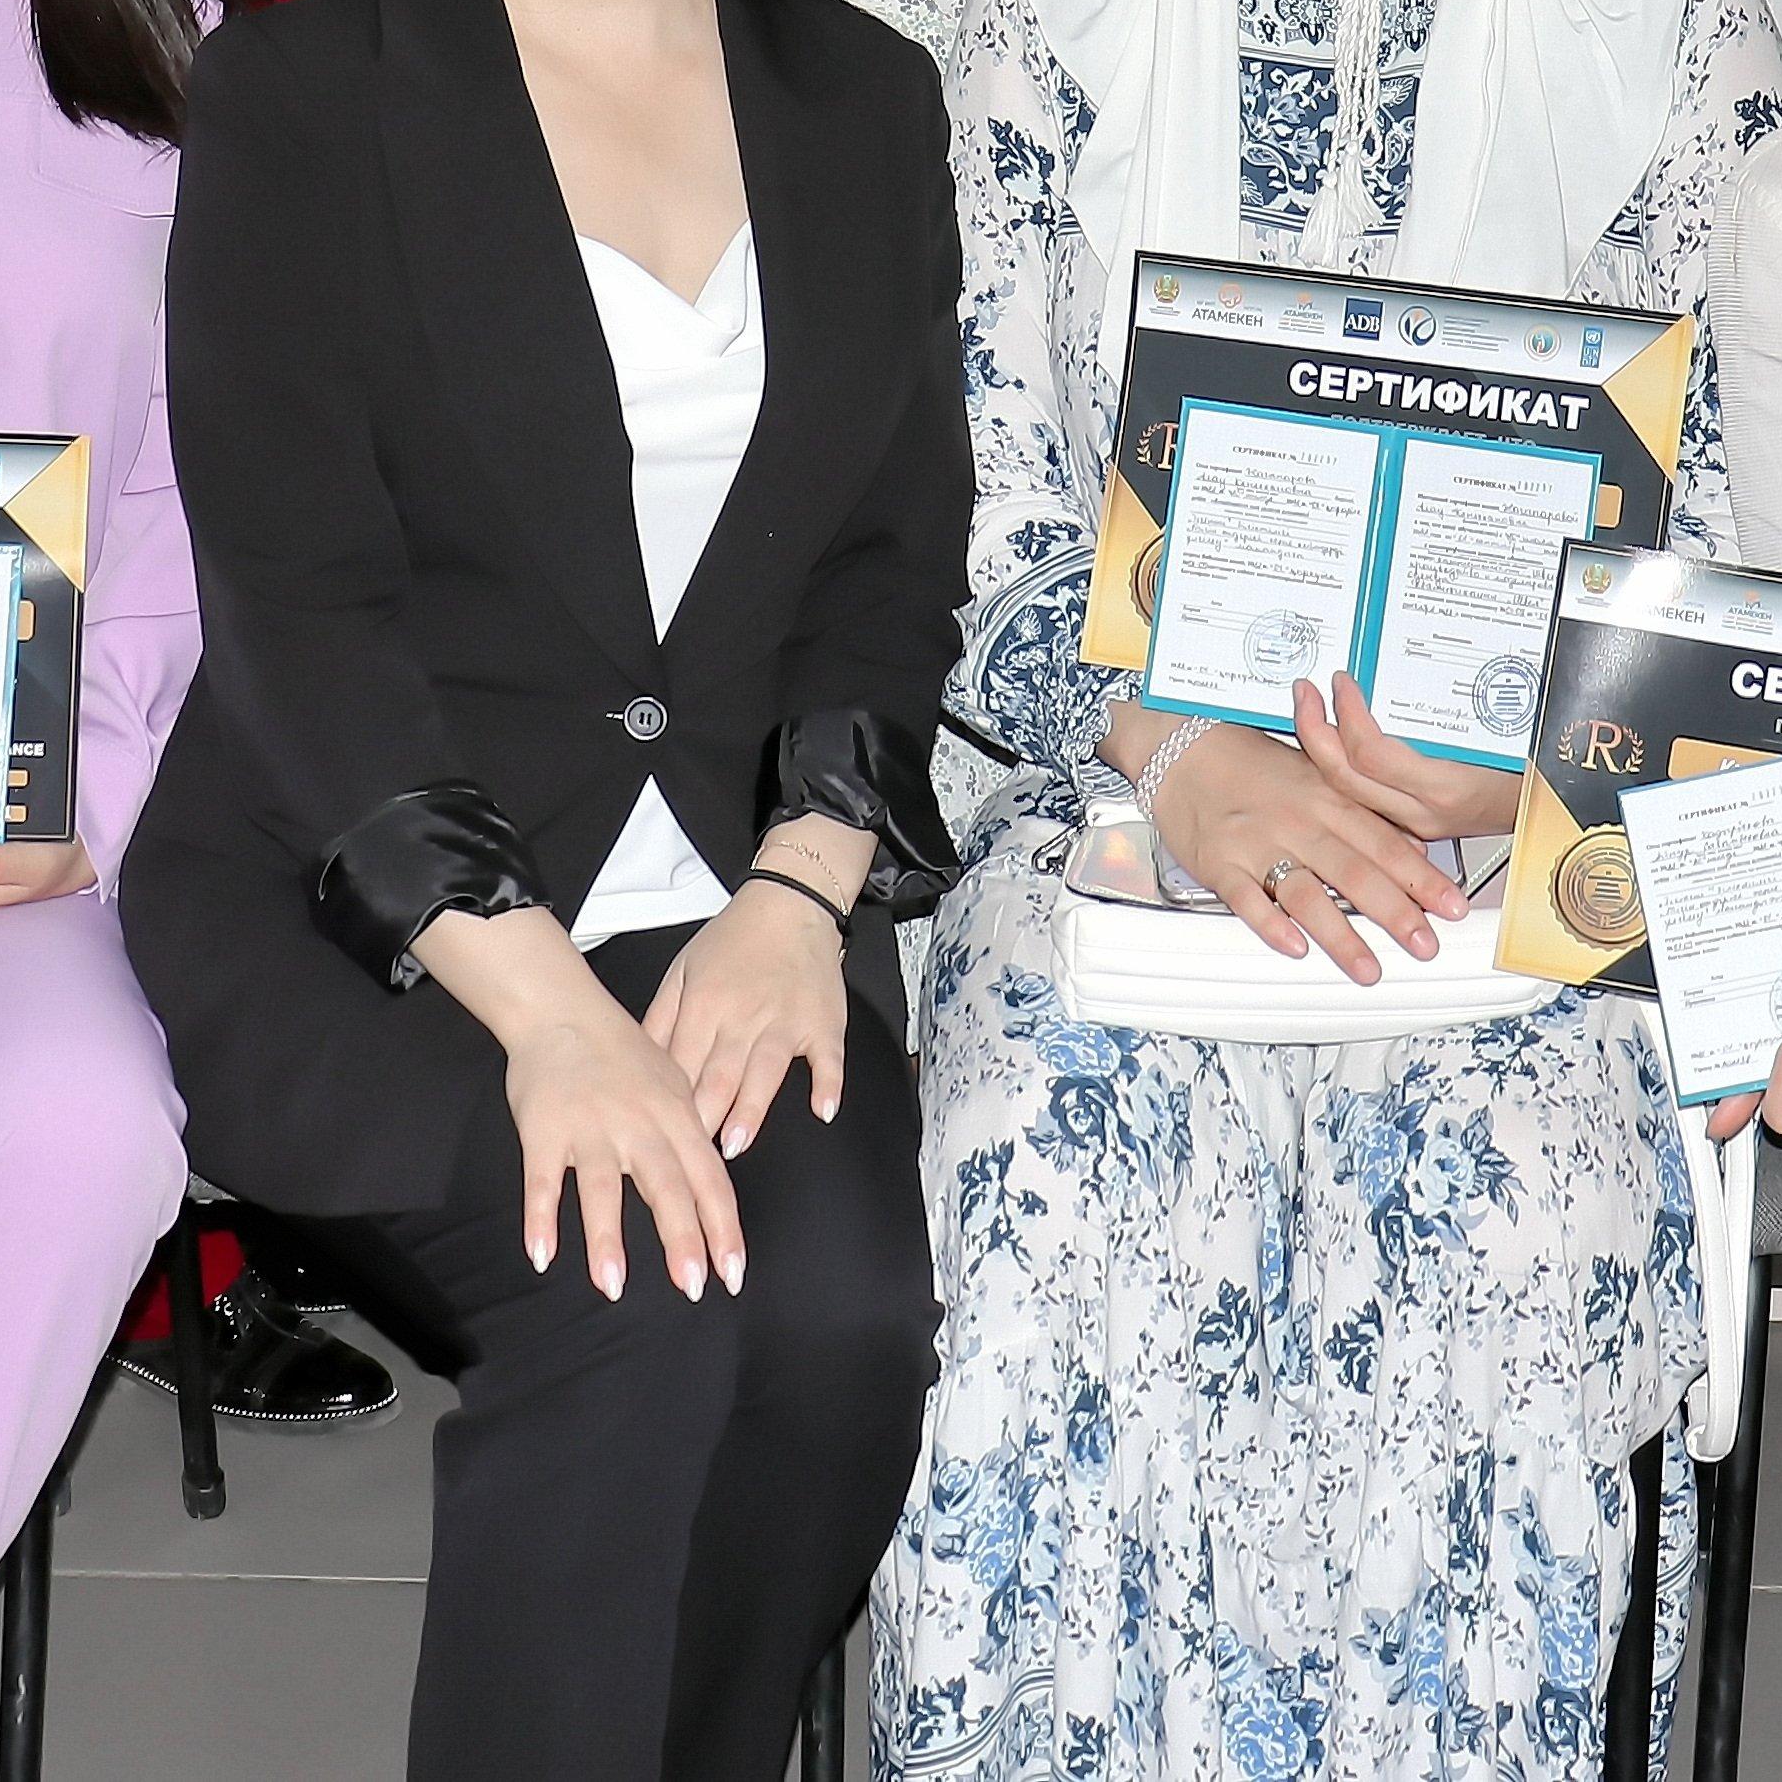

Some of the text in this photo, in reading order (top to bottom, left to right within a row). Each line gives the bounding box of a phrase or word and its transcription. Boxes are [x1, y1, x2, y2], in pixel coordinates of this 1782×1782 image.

[1191, 309, 1263, 328] АТАМЕКЕН
[1344, 313, 1381, 334] ADB
[1289, 361, 1590, 430] СЕРТИФИКАТ
[1581, 720, 1625, 774] R
